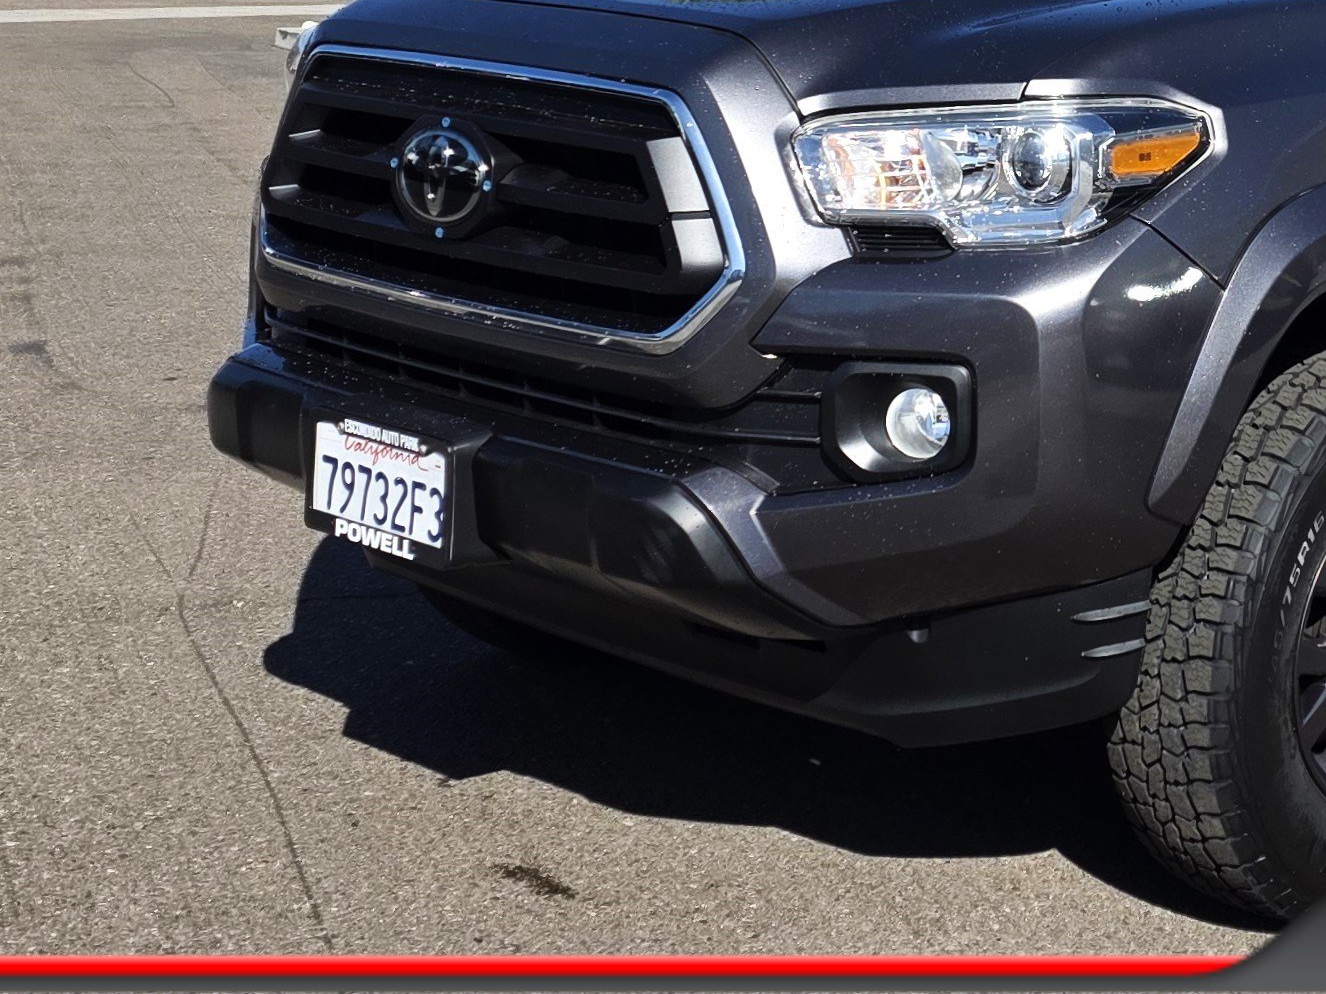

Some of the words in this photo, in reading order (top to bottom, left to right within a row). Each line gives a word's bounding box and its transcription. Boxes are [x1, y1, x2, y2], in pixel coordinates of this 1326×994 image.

[344, 435, 429, 472] California
[322, 454, 444, 543] 79732F3
[334, 518, 415, 561] POWELL
